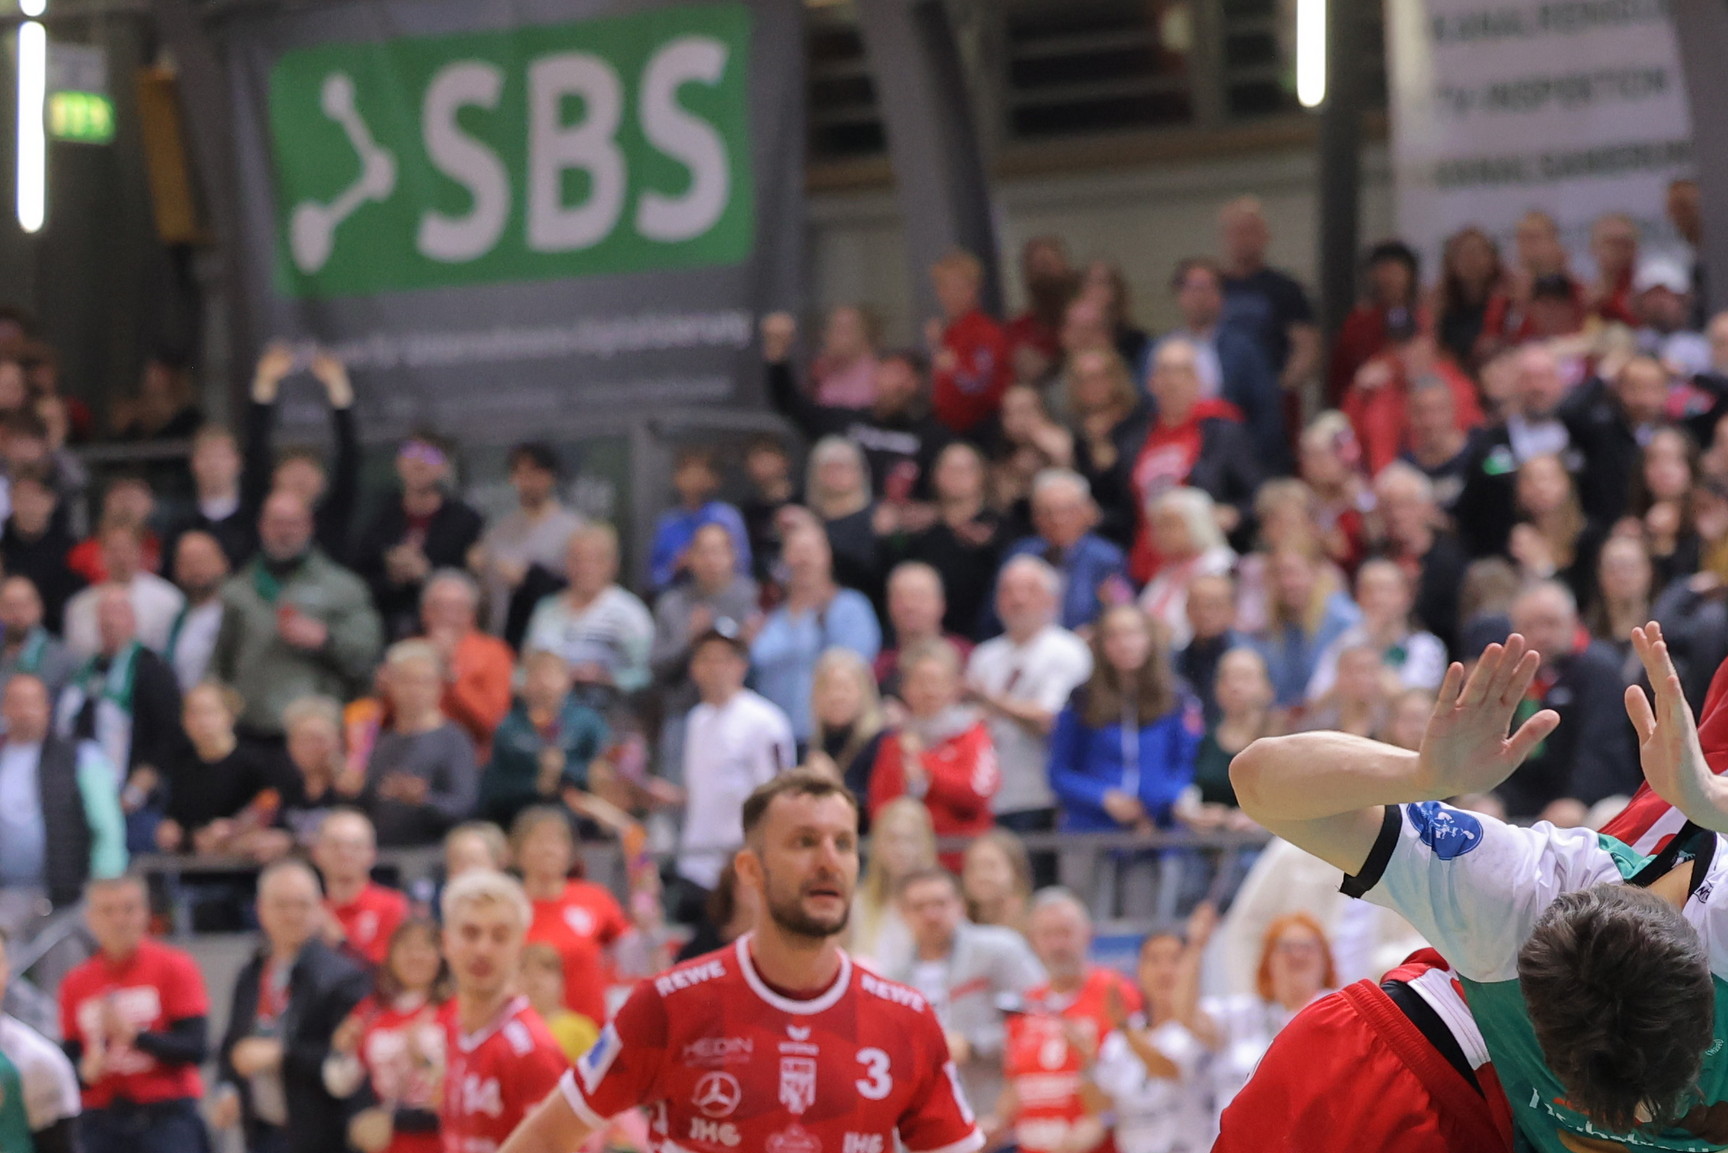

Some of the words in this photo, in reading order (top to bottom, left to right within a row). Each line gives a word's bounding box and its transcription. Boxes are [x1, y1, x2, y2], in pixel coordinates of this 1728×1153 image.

[416, 35, 729, 262] SBS
[654, 959, 727, 997] REWE
[861, 973, 925, 1013] REWE
[855, 1047, 893, 1101] 3
